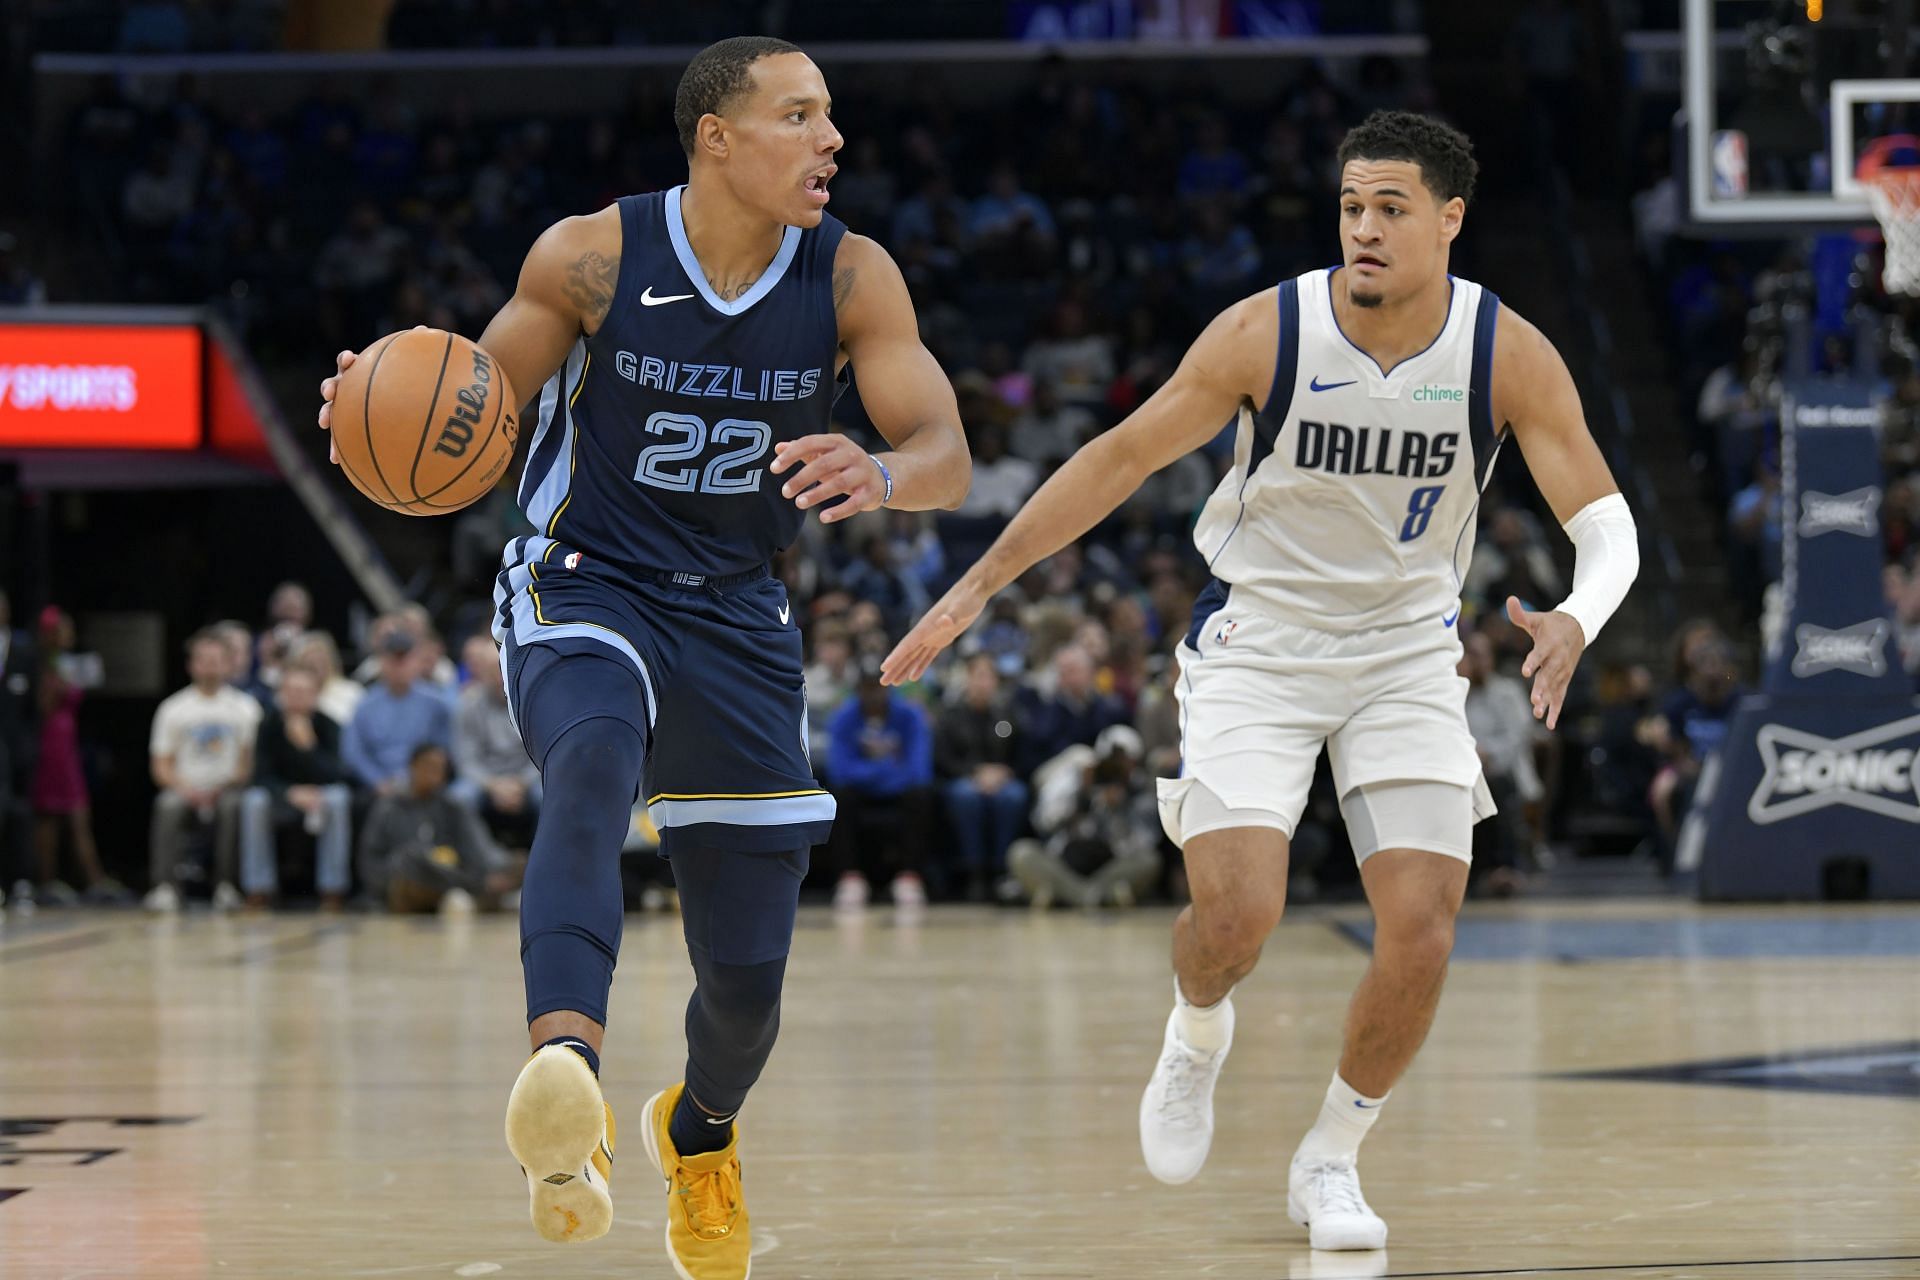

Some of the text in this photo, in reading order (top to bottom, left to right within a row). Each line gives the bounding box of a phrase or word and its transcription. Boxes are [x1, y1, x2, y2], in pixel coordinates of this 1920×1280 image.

[432, 350, 491, 458] Wilson
[615, 350, 821, 402] GRIZZLIES
[1413, 384, 1464, 402] chime
[633, 411, 772, 495] 22
[1295, 419, 1460, 478] DALLAS
[1399, 484, 1447, 543] 8
[1775, 748, 1914, 794] SONIC
